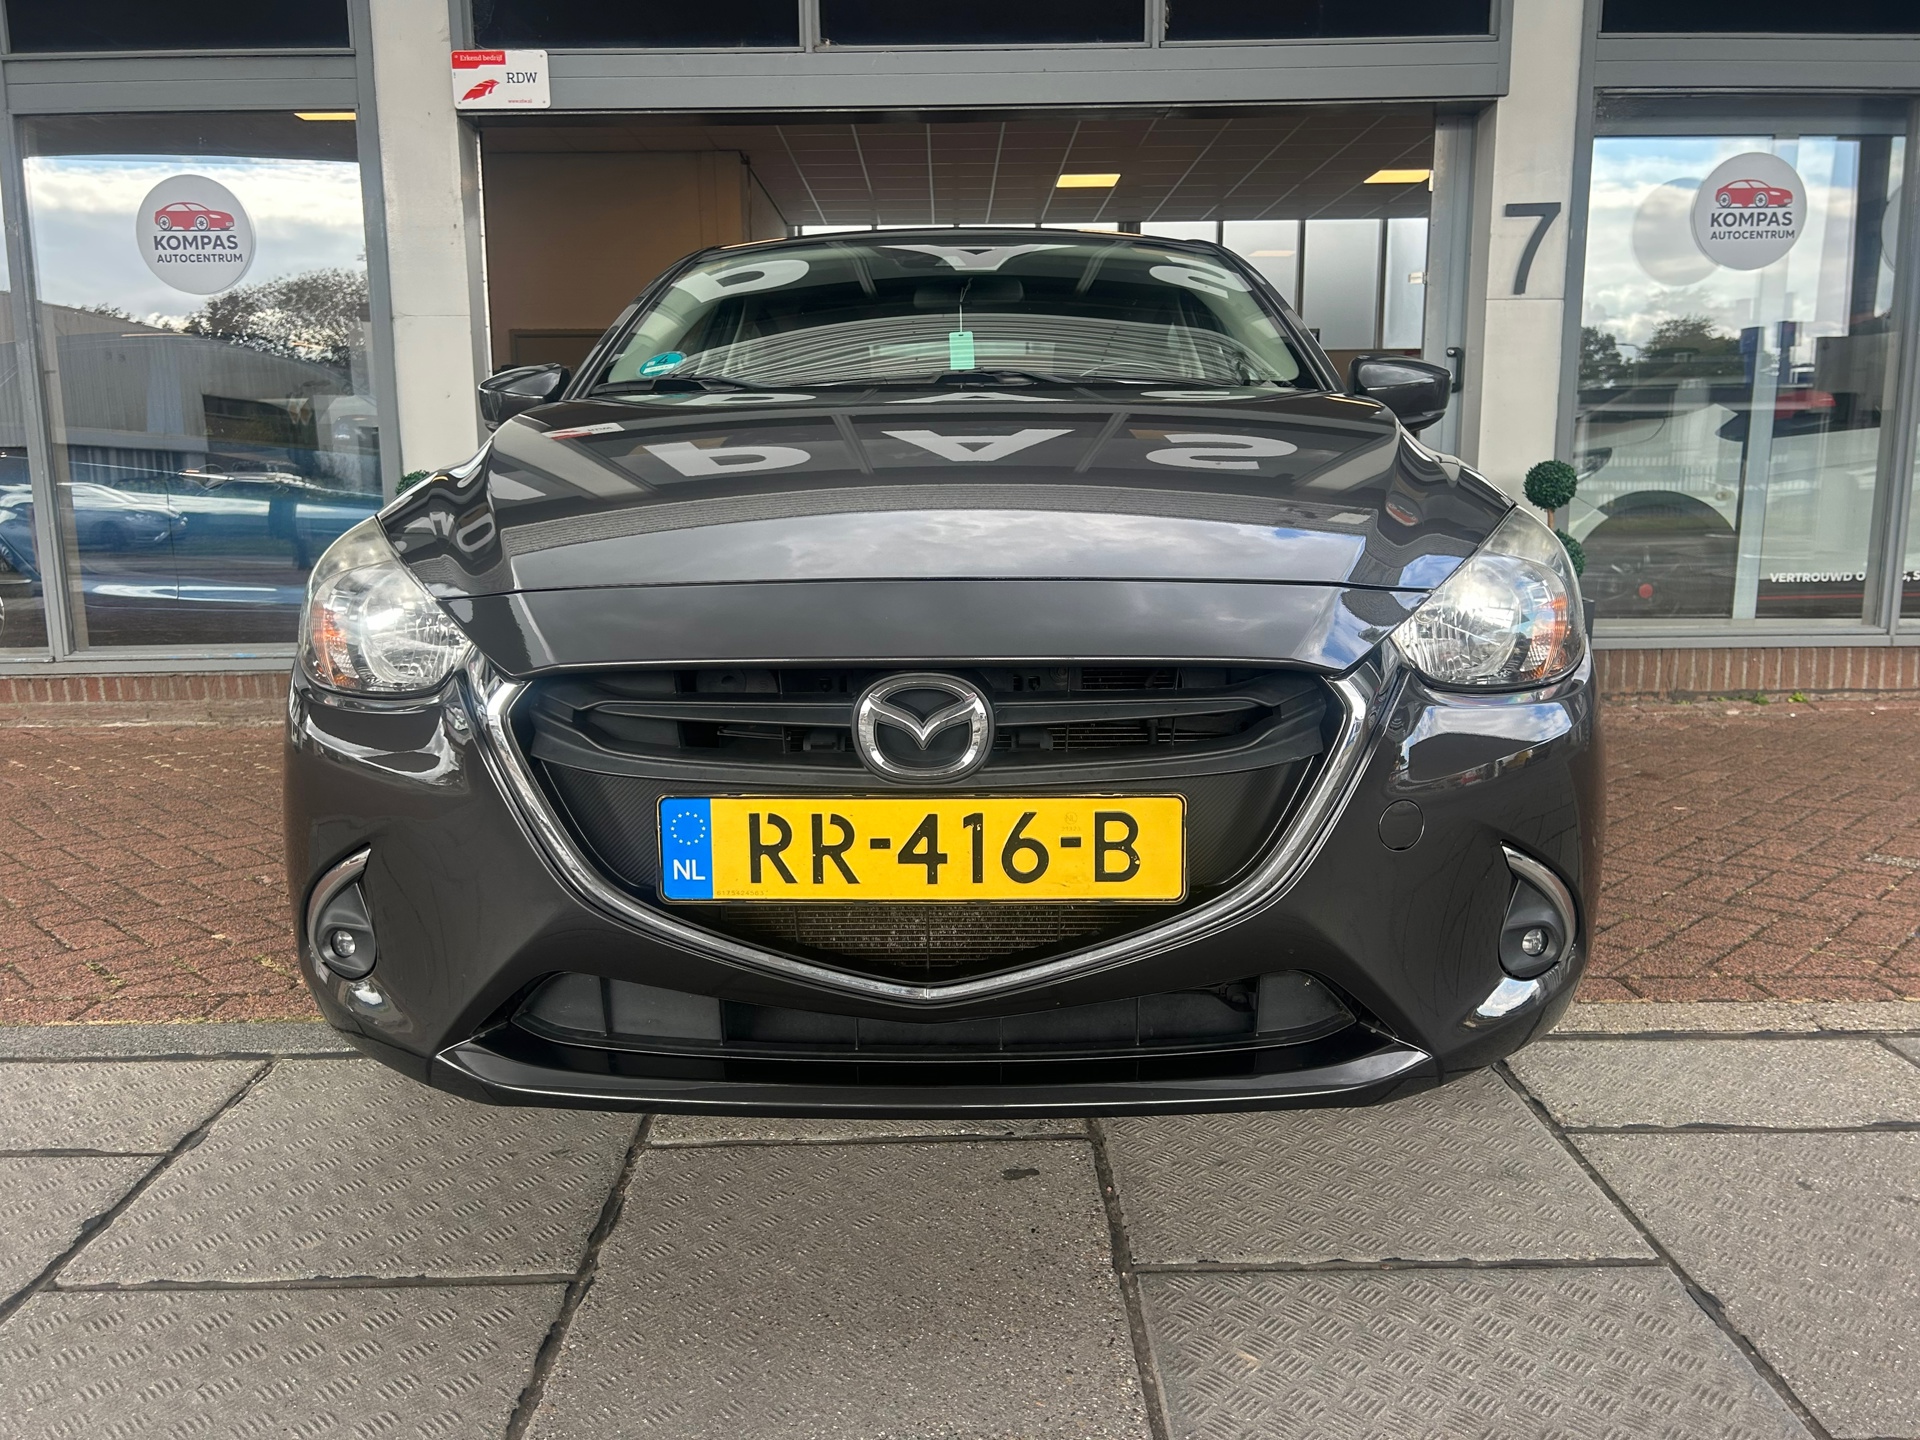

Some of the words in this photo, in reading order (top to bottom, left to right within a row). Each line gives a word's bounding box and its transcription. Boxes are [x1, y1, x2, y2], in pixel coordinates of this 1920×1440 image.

[460, 54, 482, 62] Erkend
[482, 54, 503, 63] bedrijf
[506, 71, 538, 84] RDW
[1710, 211, 1794, 228] KOMPAS
[153, 234, 239, 251] KOMPAS
[1710, 230, 1796, 241] AUTOCENTRUM
[1504, 202, 1562, 296] 7
[156, 253, 244, 264] AUTOCENTRUM
[1769, 572, 1853, 583] VERTROUWD
[748, 811, 1141, 885] RR-416-B
[672, 858, 707, 881] NL
